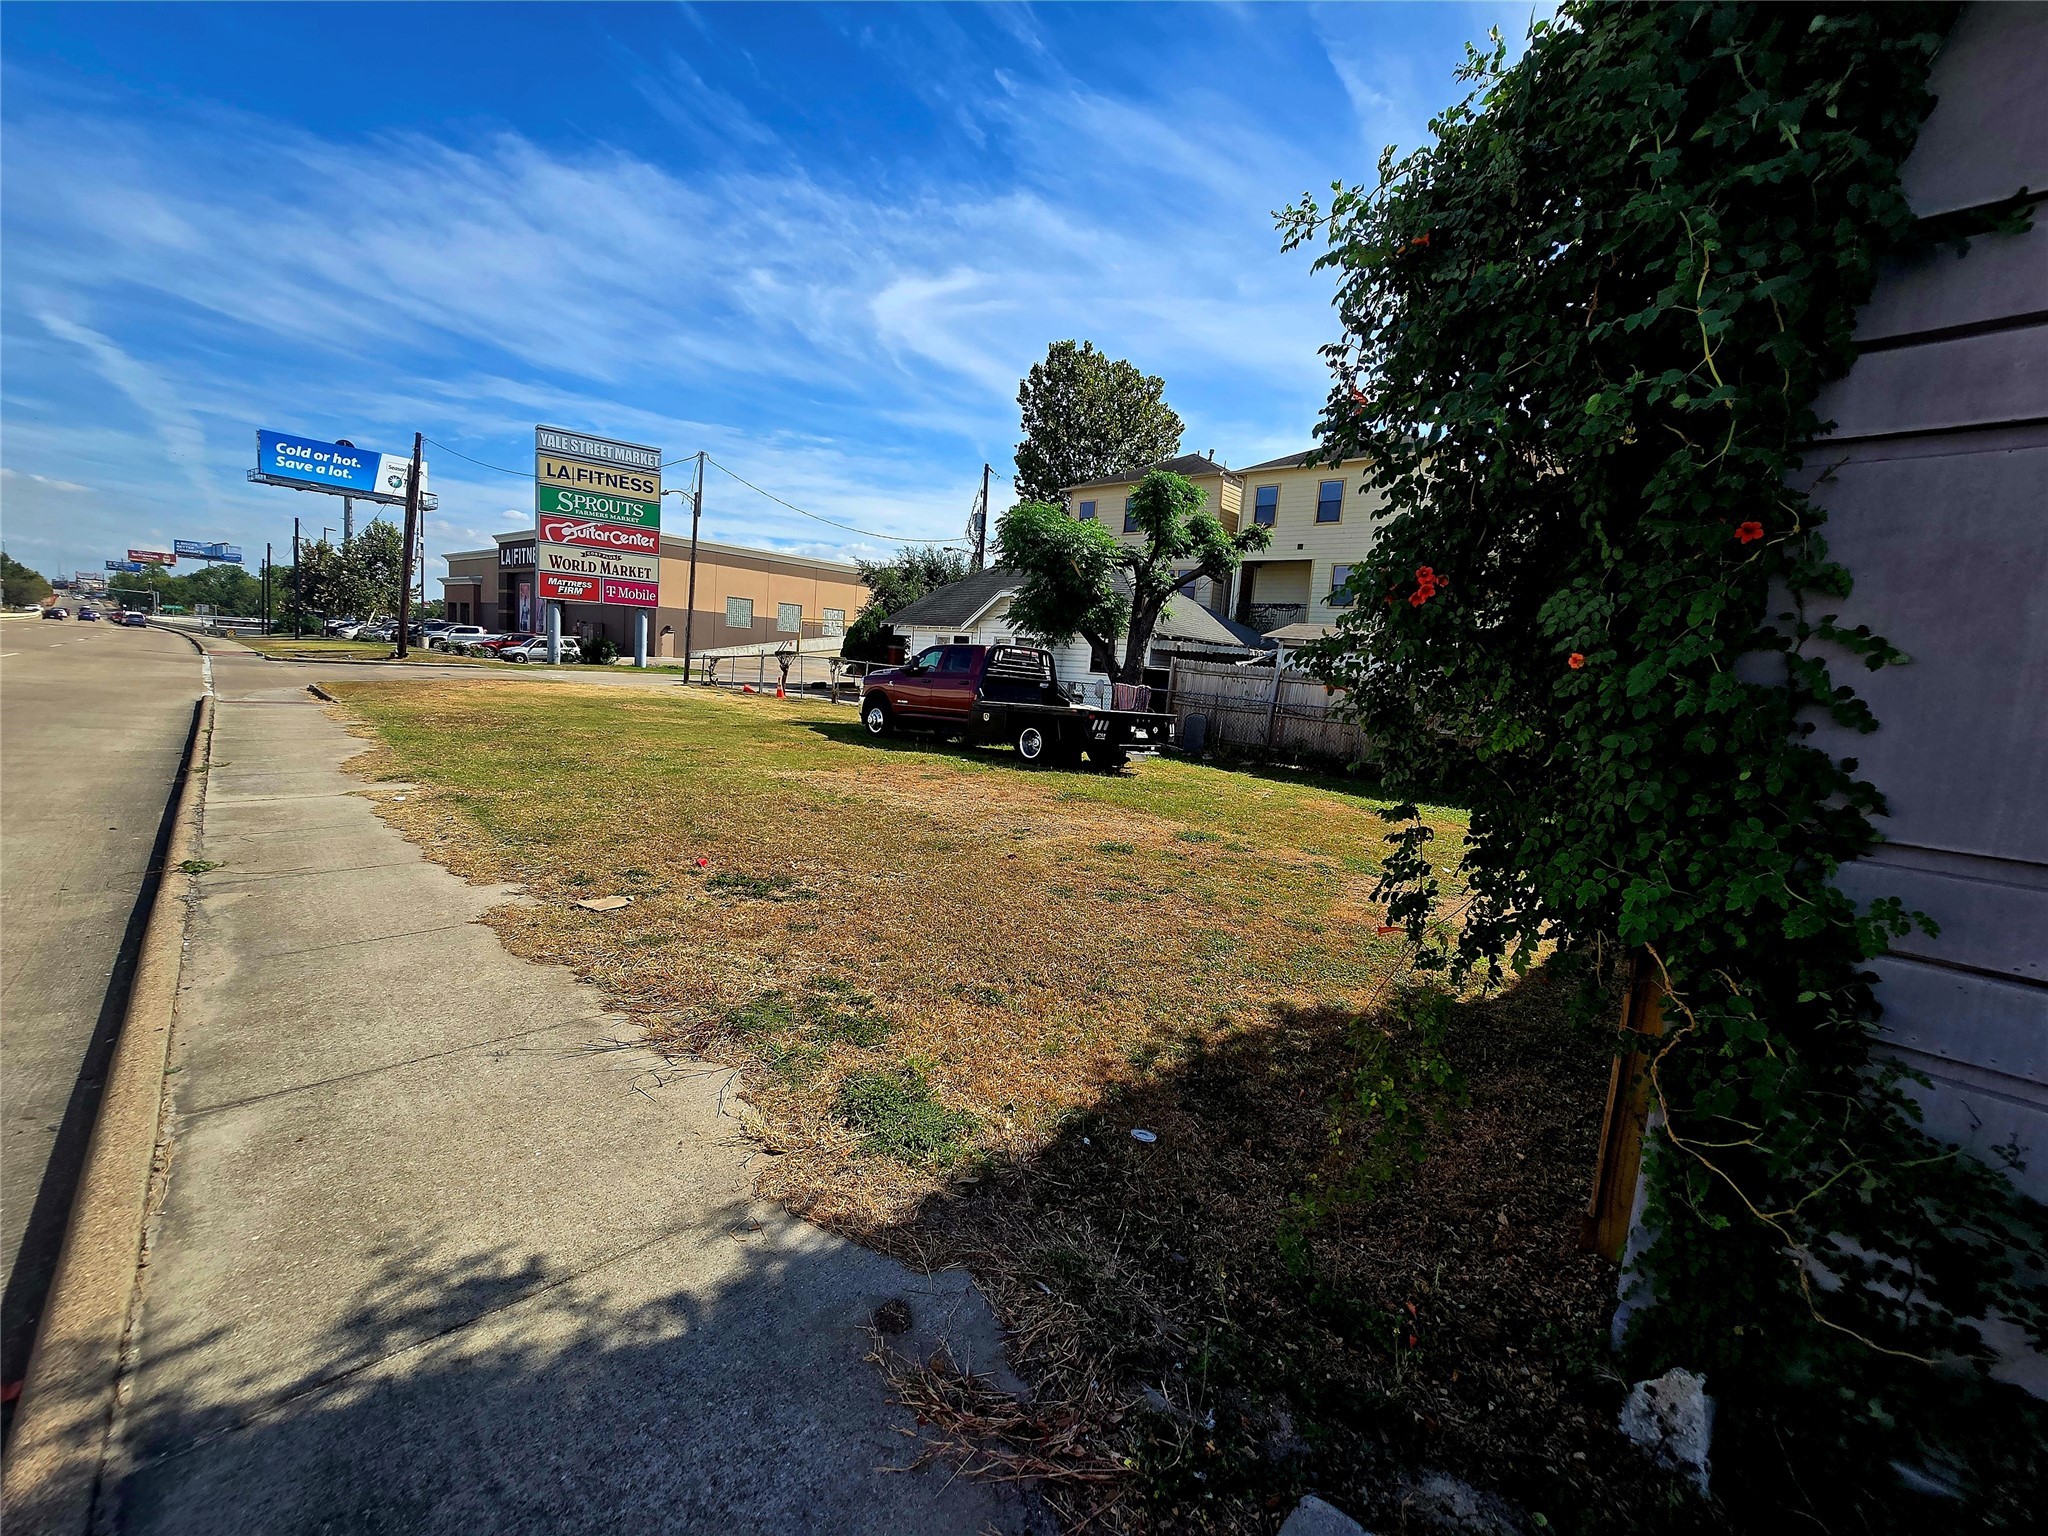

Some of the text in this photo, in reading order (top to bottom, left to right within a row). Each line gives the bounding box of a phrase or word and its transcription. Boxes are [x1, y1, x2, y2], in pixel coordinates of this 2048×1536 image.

[275, 442, 362, 468] Cold or hot.
[540, 432, 660, 468] YALE STREET MARKET
[275, 456, 353, 480] Save a lot.
[546, 462, 654, 494] LA FITNESS
[556, 491, 644, 517] SPROUTS
[575, 509, 640, 523] FARMERS MARKET
[500, 547, 536, 565] LA FITNE
[548, 554, 652, 579] WORLD MARKET
[548, 577, 593, 589] MATTRESS
[557, 586, 583, 595] FIRM
[618, 587, 656, 601] Mobile
